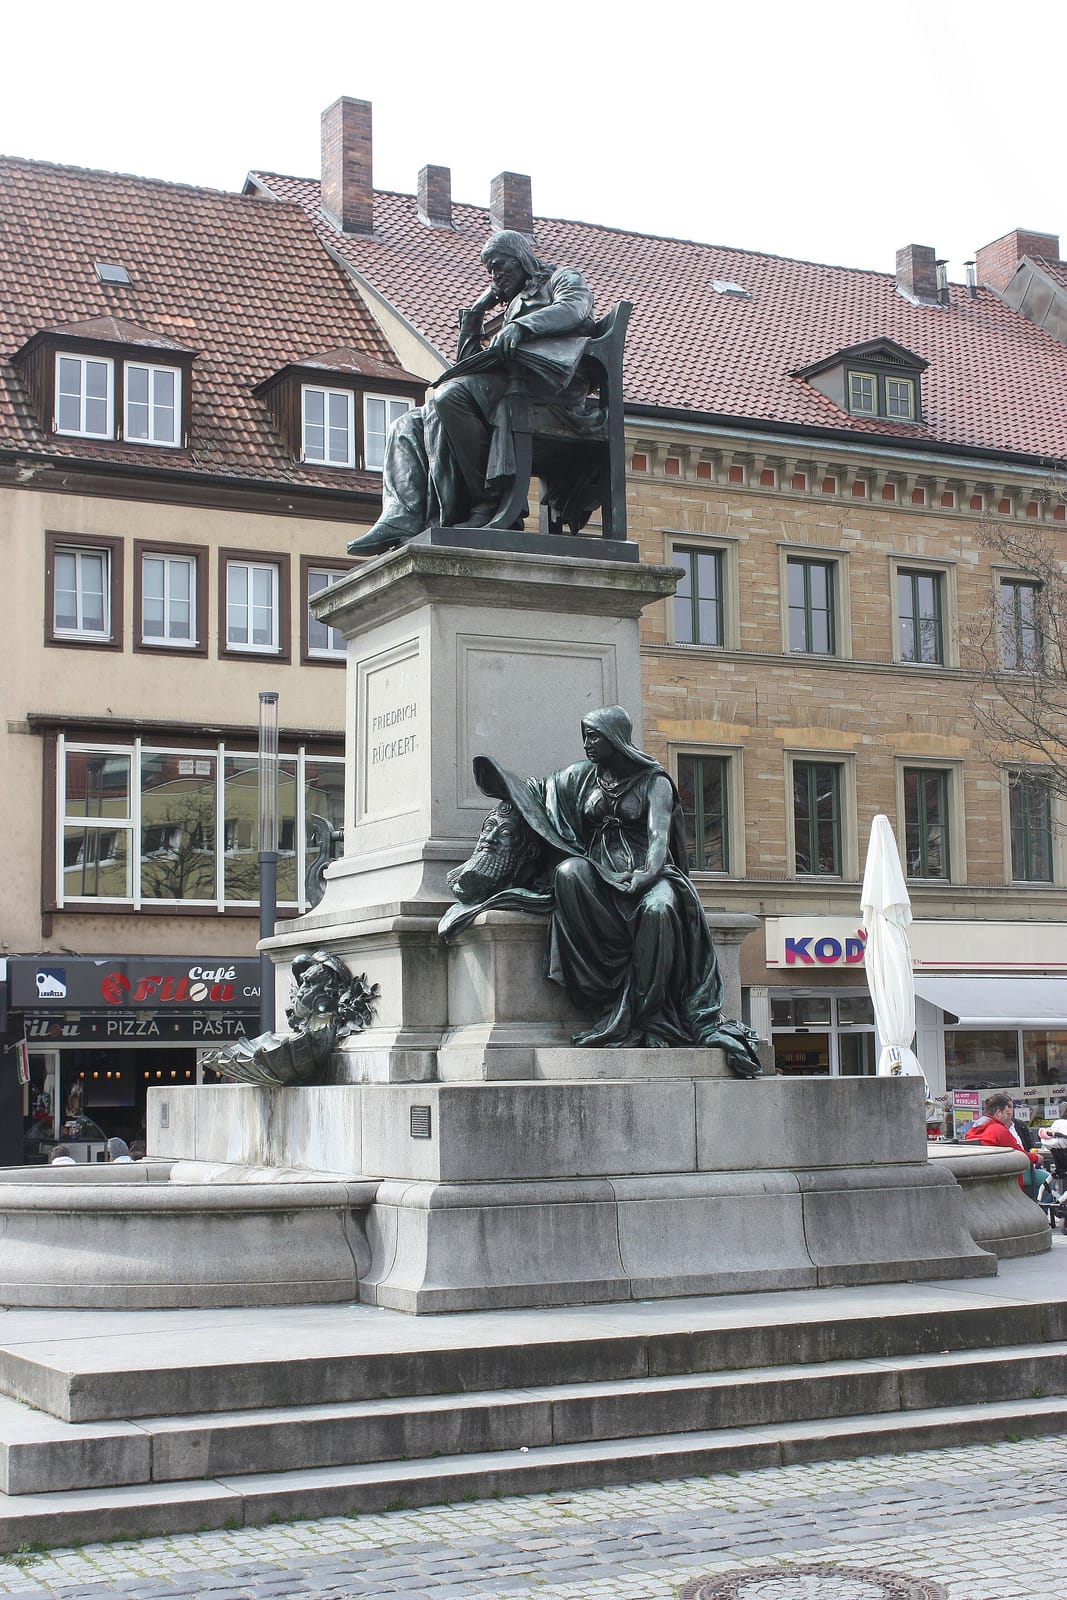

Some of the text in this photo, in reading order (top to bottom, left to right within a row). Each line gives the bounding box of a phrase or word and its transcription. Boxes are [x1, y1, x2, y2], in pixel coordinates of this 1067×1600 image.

[372, 703, 417, 732] FRIEDRICH
[785, 928, 869, 965] KOD
[188, 965, 238, 982] Café
[132, 975, 239, 1002] Filou
[107, 1020, 160, 1035] PIZZA
[192, 1020, 246, 1035] PASTA
